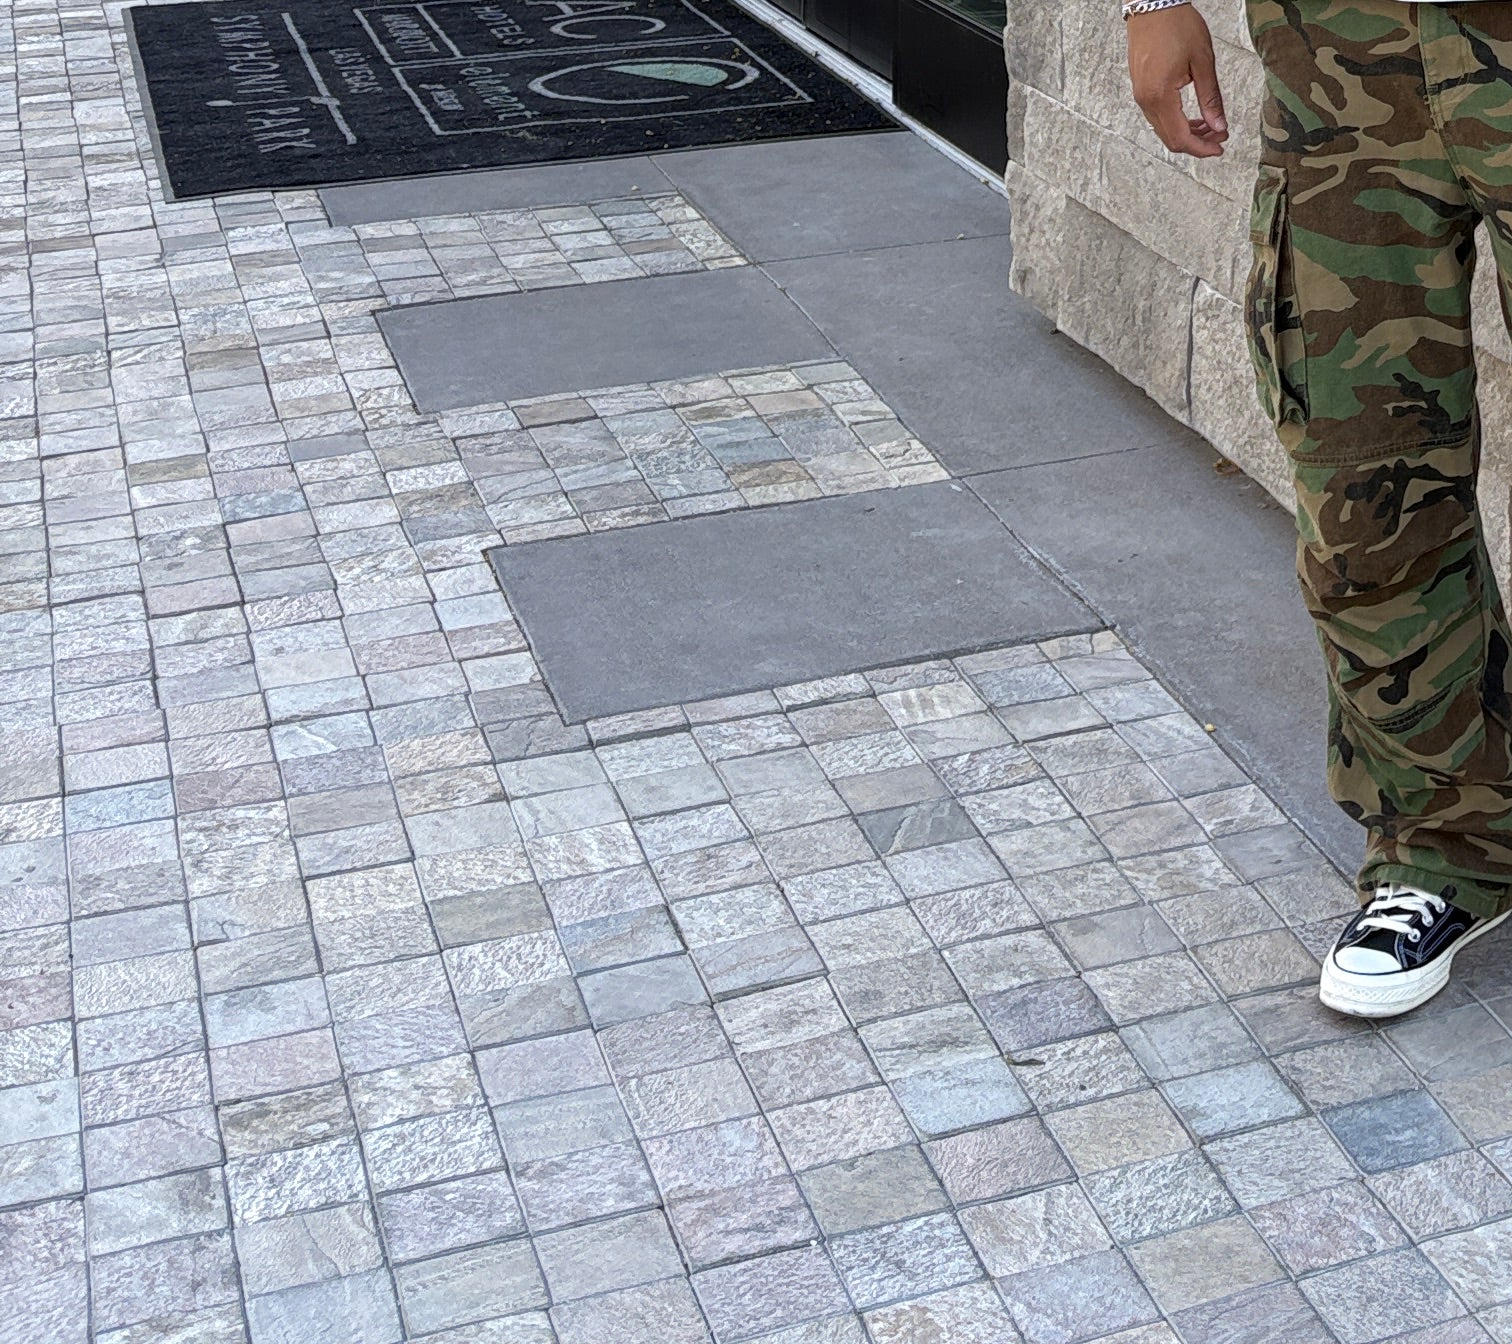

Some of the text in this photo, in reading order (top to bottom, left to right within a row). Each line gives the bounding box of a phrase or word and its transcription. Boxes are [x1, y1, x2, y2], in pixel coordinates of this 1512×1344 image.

[470, 3, 536, 46] HOTELS
[525, 0, 667, 39] AC
[210, 15, 317, 153] SYMPHONY PARK
